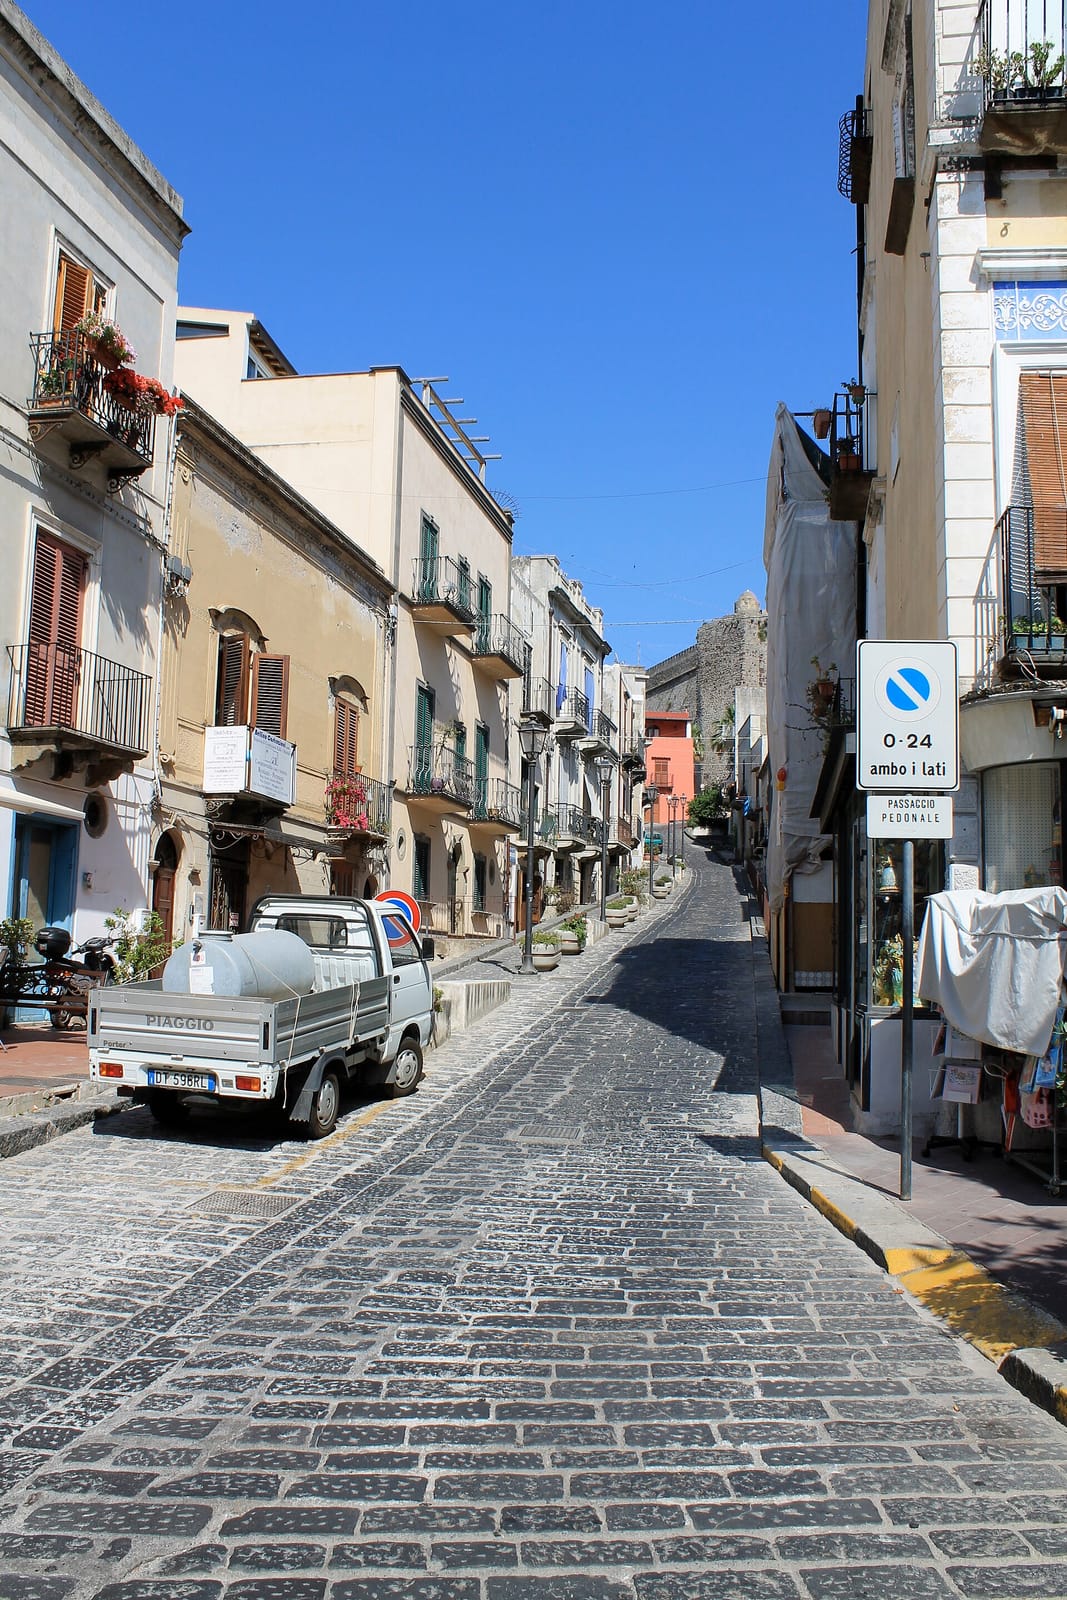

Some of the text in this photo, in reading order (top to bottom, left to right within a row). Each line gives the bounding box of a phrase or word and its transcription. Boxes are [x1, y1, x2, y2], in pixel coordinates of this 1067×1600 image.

[870, 761, 946, 776] ambo i lati
[887, 798, 935, 809] PASSAGGIO
[881, 812, 940, 823] PEDONALE
[145, 1014, 214, 1031] PIAGGIO
[103, 1039, 126, 1049] Porter
